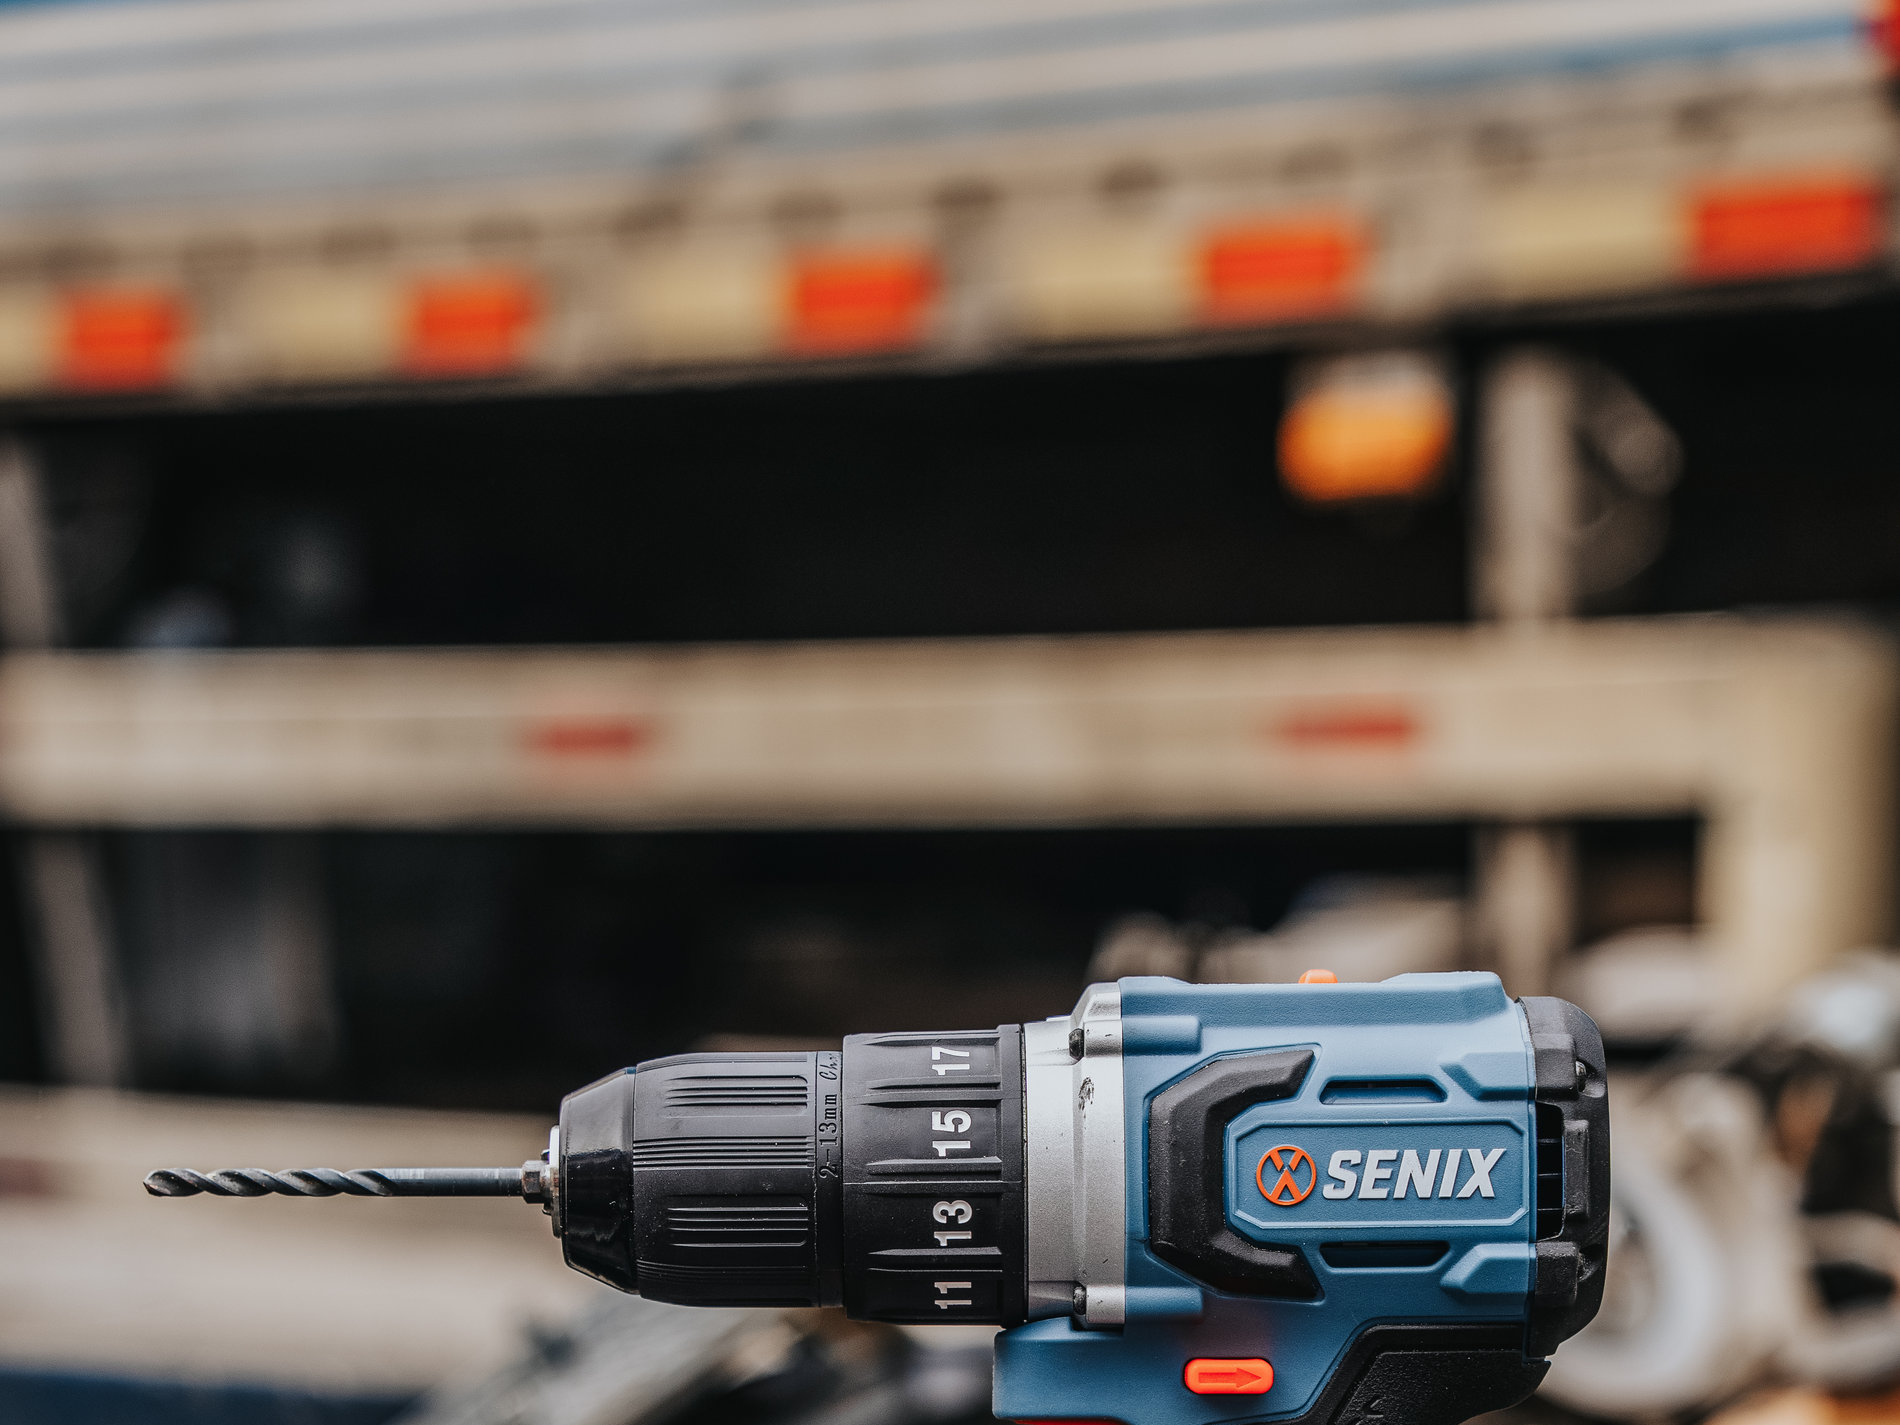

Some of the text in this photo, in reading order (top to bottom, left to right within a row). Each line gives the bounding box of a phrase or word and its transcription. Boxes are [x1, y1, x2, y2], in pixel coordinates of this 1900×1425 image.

[930, 1046, 970, 1076] 17
[931, 1110, 972, 1157] 15
[1322, 1148, 1507, 1200] SENIX
[932, 1200, 973, 1247] 13
[934, 1281, 972, 1310] 11
